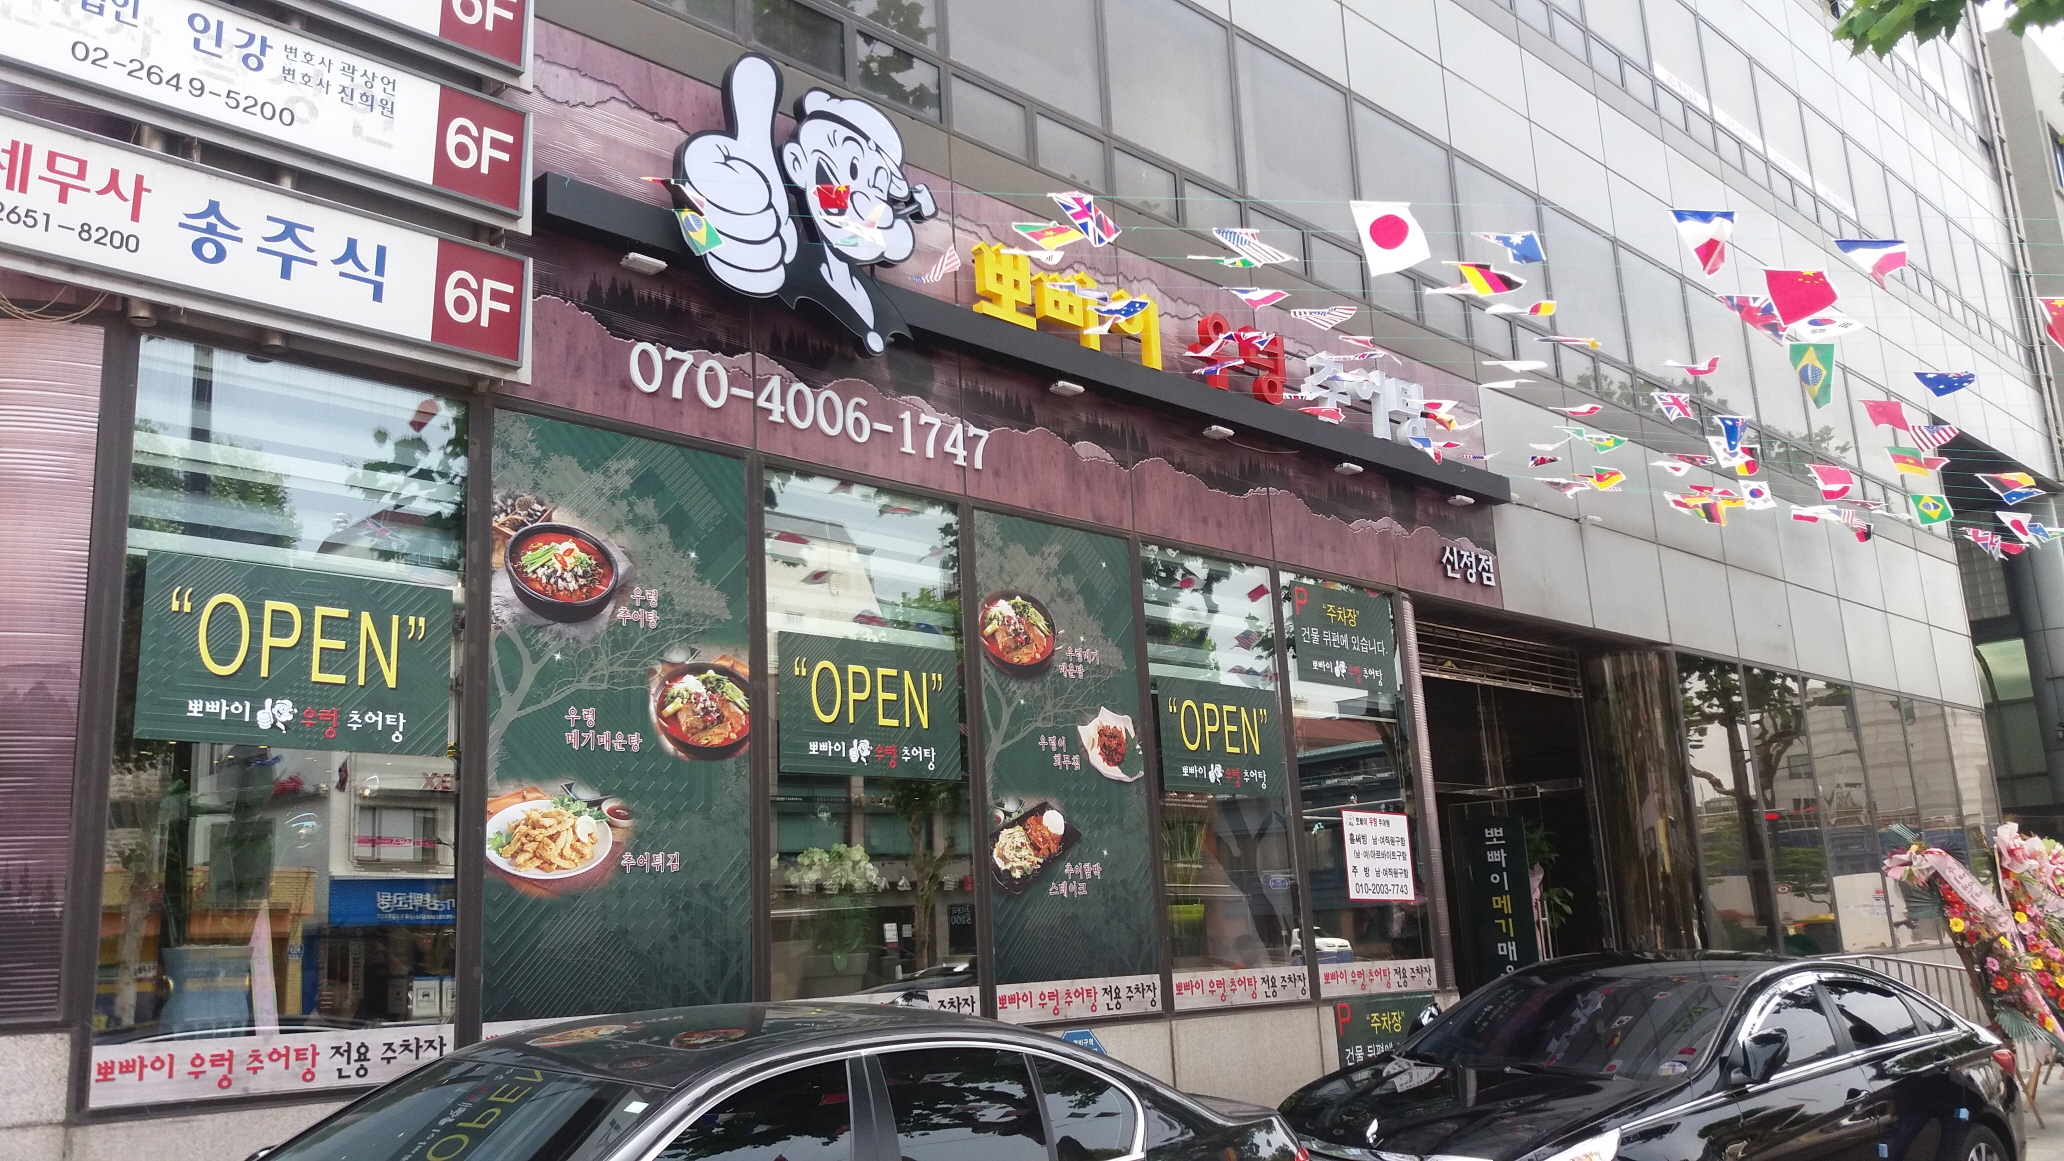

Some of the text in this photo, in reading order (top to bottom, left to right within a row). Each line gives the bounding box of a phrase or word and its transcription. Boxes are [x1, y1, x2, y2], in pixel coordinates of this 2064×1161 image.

[187, 12, 274, 73] 인강
[70, 40, 296, 128] 02-2649-5200
[283, 43, 397, 97] 변호사 곽상언
[281, 64, 395, 120] 변호사 진희원
[444, 115, 515, 176] 6F
[0, 138, 389, 304] 세무사 송주식
[443, 269, 515, 329] 6F
[629, 341, 990, 470] 070-4006-1747
[1439, 544, 1496, 590] 신정점
[630, 586, 659, 608] 우렁
[1293, 586, 1309, 616] P
[616, 606, 660, 629] 추어탕
[1300, 627, 1389, 657] 건물 뒤편에 있습니다.
[1058, 663, 1085, 680] 매운탕
[1312, 659, 1334, 674] 뽀빠이
[1363, 667, 1383, 687] 추어탕
[187, 697, 406, 743] 뽀빠이 우렁 추어탕
[564, 705, 597, 728] 우렁
[564, 730, 643, 753] 메기매운탕
[807, 739, 937, 771] 뽀빠이 우렁 추어탕
[1181, 765, 1207, 779] 뽀빠이
[1243, 769, 1267, 790] 추어탕
[620, 852, 681, 873] 추어튀김
[1064, 861, 1103, 880] 추어함박
[1048, 880, 1088, 898] 스테이크
[1355, 882, 1409, 895] 010-2003-7743
[1175, 972, 1307, 1002] 뽀빠이 우렁 추어탕 전용 주차장
[1323, 964, 1432, 991] 뽀빠이 우렁 추어탕 전용 주차장
[998, 981, 1157, 1016] 뽀빠이 우렁 추어탕 전용 주차장
[1336, 1002, 1352, 1037] P
[94, 1052, 175, 1083] 뽀빠이
[186, 1049, 235, 1090] 우렁
[245, 1042, 320, 1083] 추어탕
[329, 1040, 371, 1080] 전용
[1345, 1045, 1365, 1067] 건물
